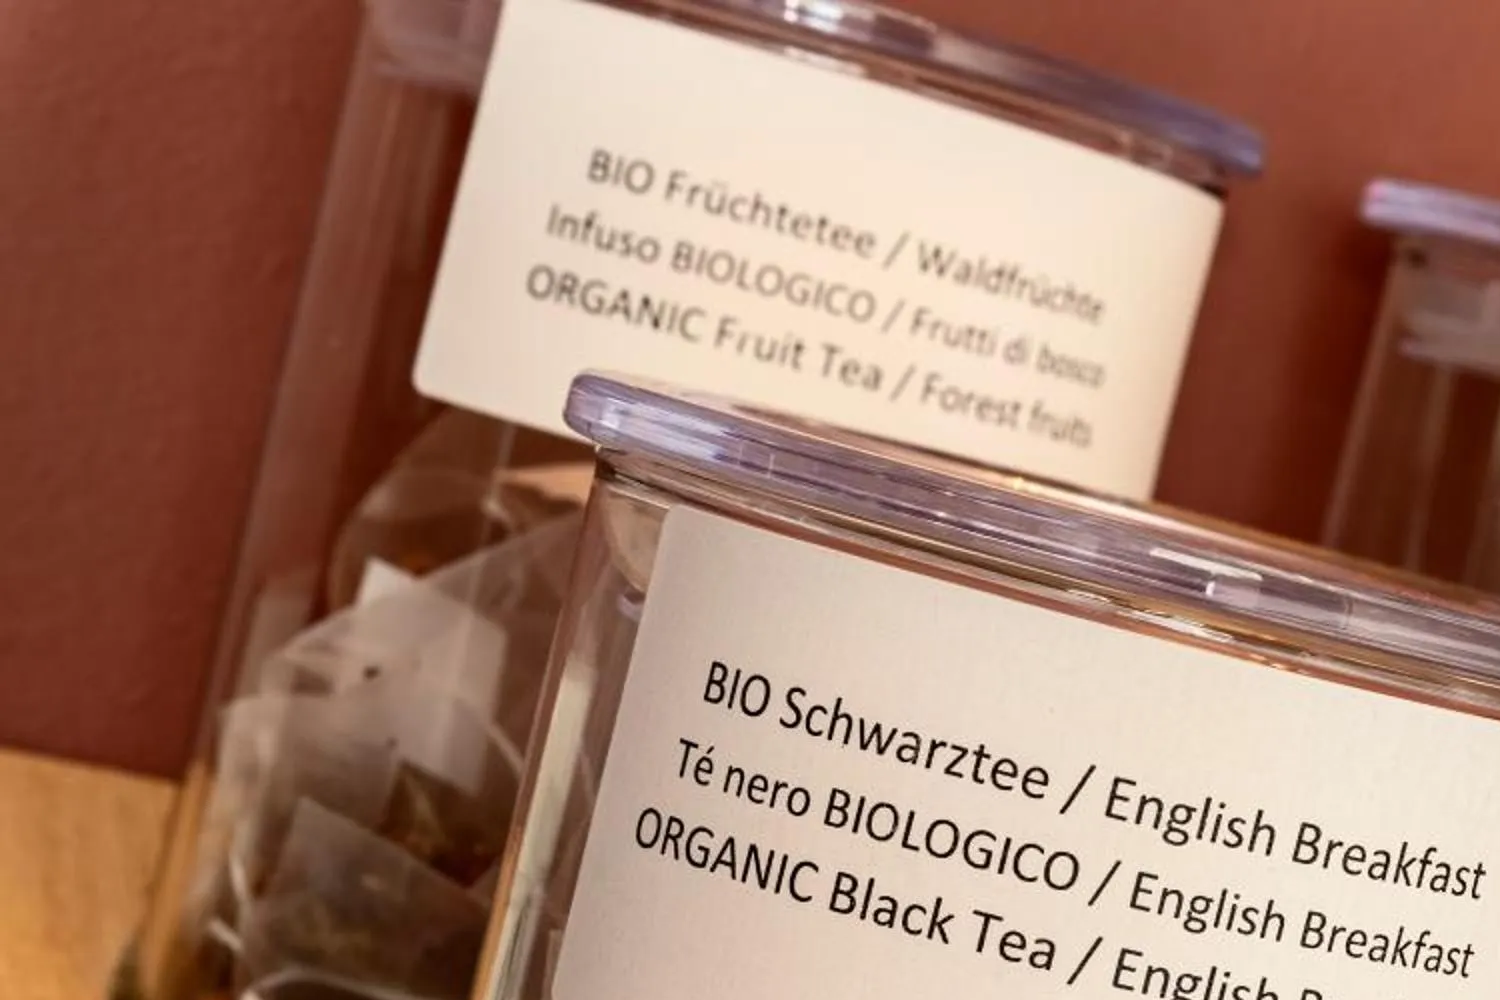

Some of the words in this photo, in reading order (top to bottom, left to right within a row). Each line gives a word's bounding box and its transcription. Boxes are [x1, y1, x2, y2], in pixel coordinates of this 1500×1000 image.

[545, 206, 661, 264] Infuso
[672, 243, 877, 324] BIOLOGICO
[882, 299, 905, 333] /
[911, 306, 997, 356] Frutti
[587, 148, 654, 196] BIO
[664, 170, 877, 258] Früchtetee
[884, 231, 910, 268] /
[525, 265, 705, 343] ORGANIC
[714, 315, 806, 372] Fruit
[820, 345, 882, 393] Tea
[890, 364, 916, 402] /
[921, 372, 1021, 429] Forest
[677, 738, 715, 787] Té
[722, 766, 811, 818] nero
[823, 789, 1080, 892] BIOLOGICO
[1088, 860, 1121, 907] /
[1129, 871, 1286, 944] English
[1300, 912, 1475, 979] Breakfast
[703, 661, 770, 718] BIO
[779, 686, 1050, 800] Schwarztee
[1060, 765, 1096, 814] /
[1104, 777, 1277, 857] English
[1291, 822, 1487, 901] Breakfast
[635, 808, 819, 903] ORGANIC
[829, 871, 954, 946] Black
[973, 911, 1056, 971] Tea
[1068, 937, 1103, 986] /
